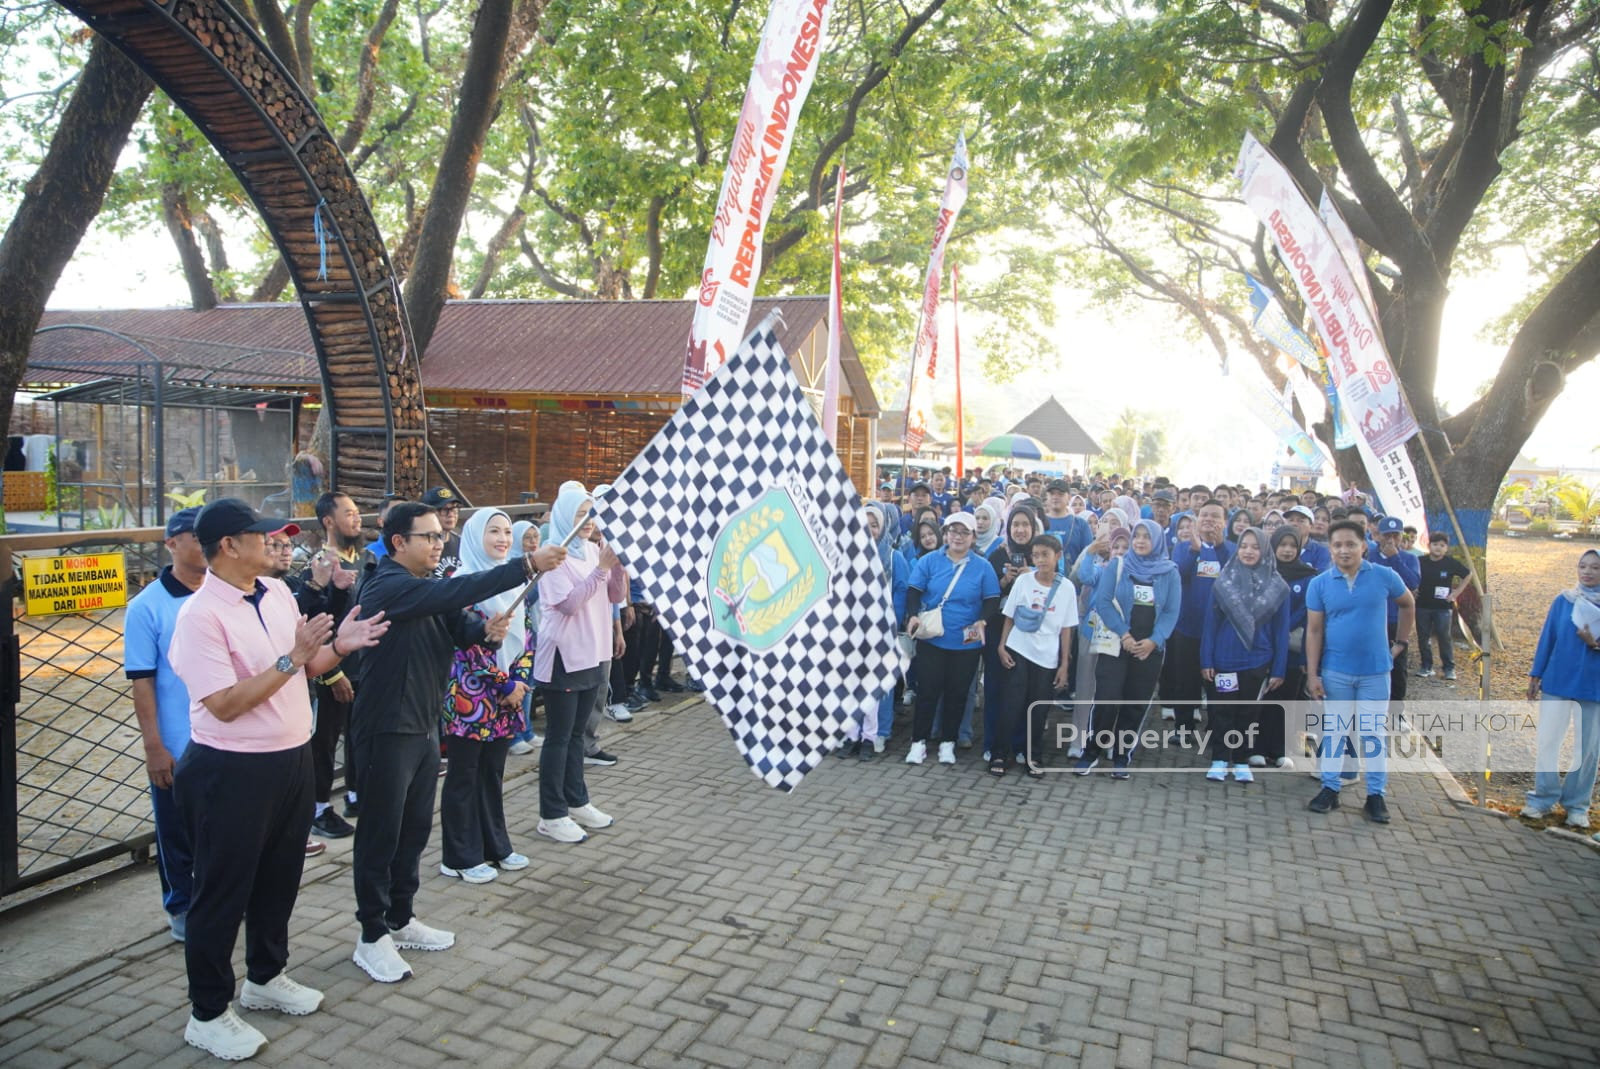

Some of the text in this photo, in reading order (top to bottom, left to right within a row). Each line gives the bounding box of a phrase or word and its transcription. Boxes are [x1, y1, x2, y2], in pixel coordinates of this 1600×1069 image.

[808, 514, 843, 570] MADIUN
[54, 557, 98, 570] DI MOHON
[33, 569, 118, 585] TIDAK MEMBAWA
[28, 581, 123, 600] MAKANAN DAN MINUMAN
[1135, 591, 1148, 600] 05
[54, 597, 103, 611] DARI LUAR
[1219, 679, 1231, 688] 03
